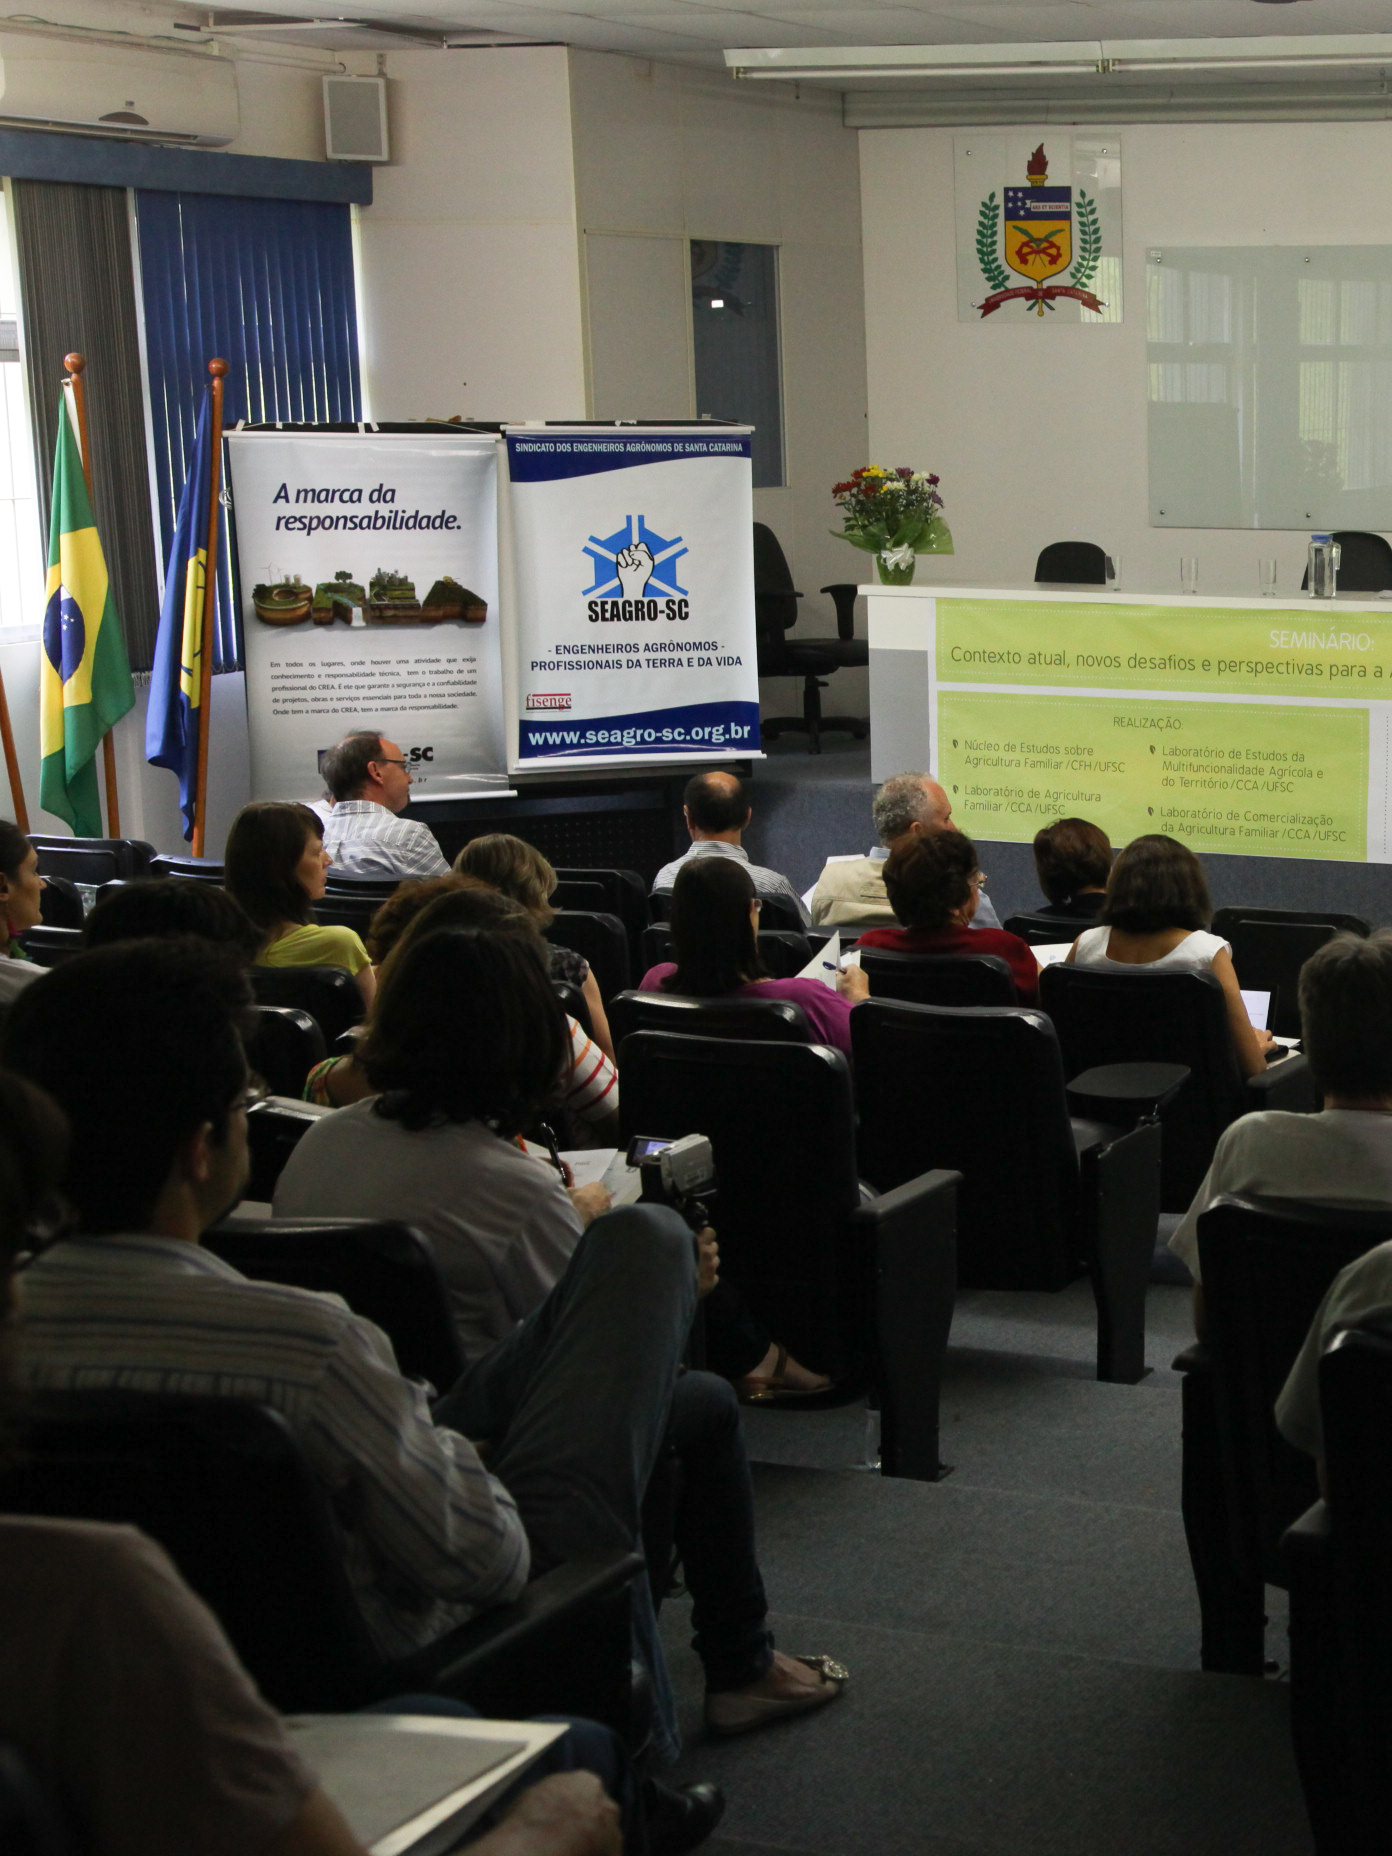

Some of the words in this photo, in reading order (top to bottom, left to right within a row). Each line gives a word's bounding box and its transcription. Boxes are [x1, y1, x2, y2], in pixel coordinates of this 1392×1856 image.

[516, 442, 554, 452] SINDICATO
[556, 442, 572, 452] DOS
[573, 442, 624, 452] ENGENHEIROS
[626, 440, 672, 452] AGRÔNOMOS
[674, 442, 684, 452] DE
[685, 442, 708, 452] SANTA
[709, 442, 743, 452] CATARINA
[273, 483, 290, 504] A
[295, 488, 363, 504] marca
[368, 484, 396, 504] da
[276, 510, 462, 536] responsabilidade.
[588, 598, 689, 622] SEAGRO-SC
[555, 643, 640, 655] ENGENHEIROS
[643, 640, 718, 652] AGRÔNOMOS
[1269, 630, 1376, 652] SEMINÁRIO:
[462, 656, 476, 664] exija
[531, 659, 622, 671] PROFISSIONAIS
[626, 658, 642, 669] DA
[645, 658, 684, 668] TERRA
[687, 658, 694, 667] E
[697, 656, 713, 667] DA
[716, 656, 742, 666] VIDA
[950, 646, 1022, 666] Contexto
[1027, 650, 1070, 669] atual,
[1076, 654, 1122, 669] novos
[1127, 653, 1196, 672] desafios
[1201, 659, 1212, 672] e
[1217, 658, 1324, 678] perspectivas
[1329, 665, 1367, 682] para
[1374, 667, 1384, 678] a
[525, 692, 572, 711] fisenge
[1114, 716, 1184, 732] REALIZAÇÃO:
[528, 722, 750, 746] www.seagro-sc.org.br
[965, 740, 1000, 752] Núcleo
[1004, 742, 1016, 753] de
[1020, 742, 1060, 755] Estudos
[1064, 744, 1094, 756] sobre
[1162, 746, 1224, 758] Laboratório
[1228, 748, 1242, 759] de
[1246, 749, 1288, 762] Estudos
[1292, 751, 1305, 762] da
[965, 756, 1020, 768] Agricultura
[1024, 758, 1063, 770] Familiar
[1162, 760, 1264, 776] Multifuncionalidade
[1269, 765, 1312, 780] Agrícola
[1316, 770, 1324, 778] e
[1162, 776, 1174, 787] do
[964, 784, 1024, 798] Laboratório
[1028, 788, 1040, 798] de
[1045, 789, 1102, 803] Agricultura
[964, 800, 1001, 812] Familiar
[1160, 806, 1222, 820] Laboratório
[1226, 808, 1240, 820] de
[1244, 810, 1334, 828] Comercialização
[1161, 822, 1174, 832] da
[1178, 823, 1236, 837] Agricultura
[1239, 826, 1280, 838] Familiar
